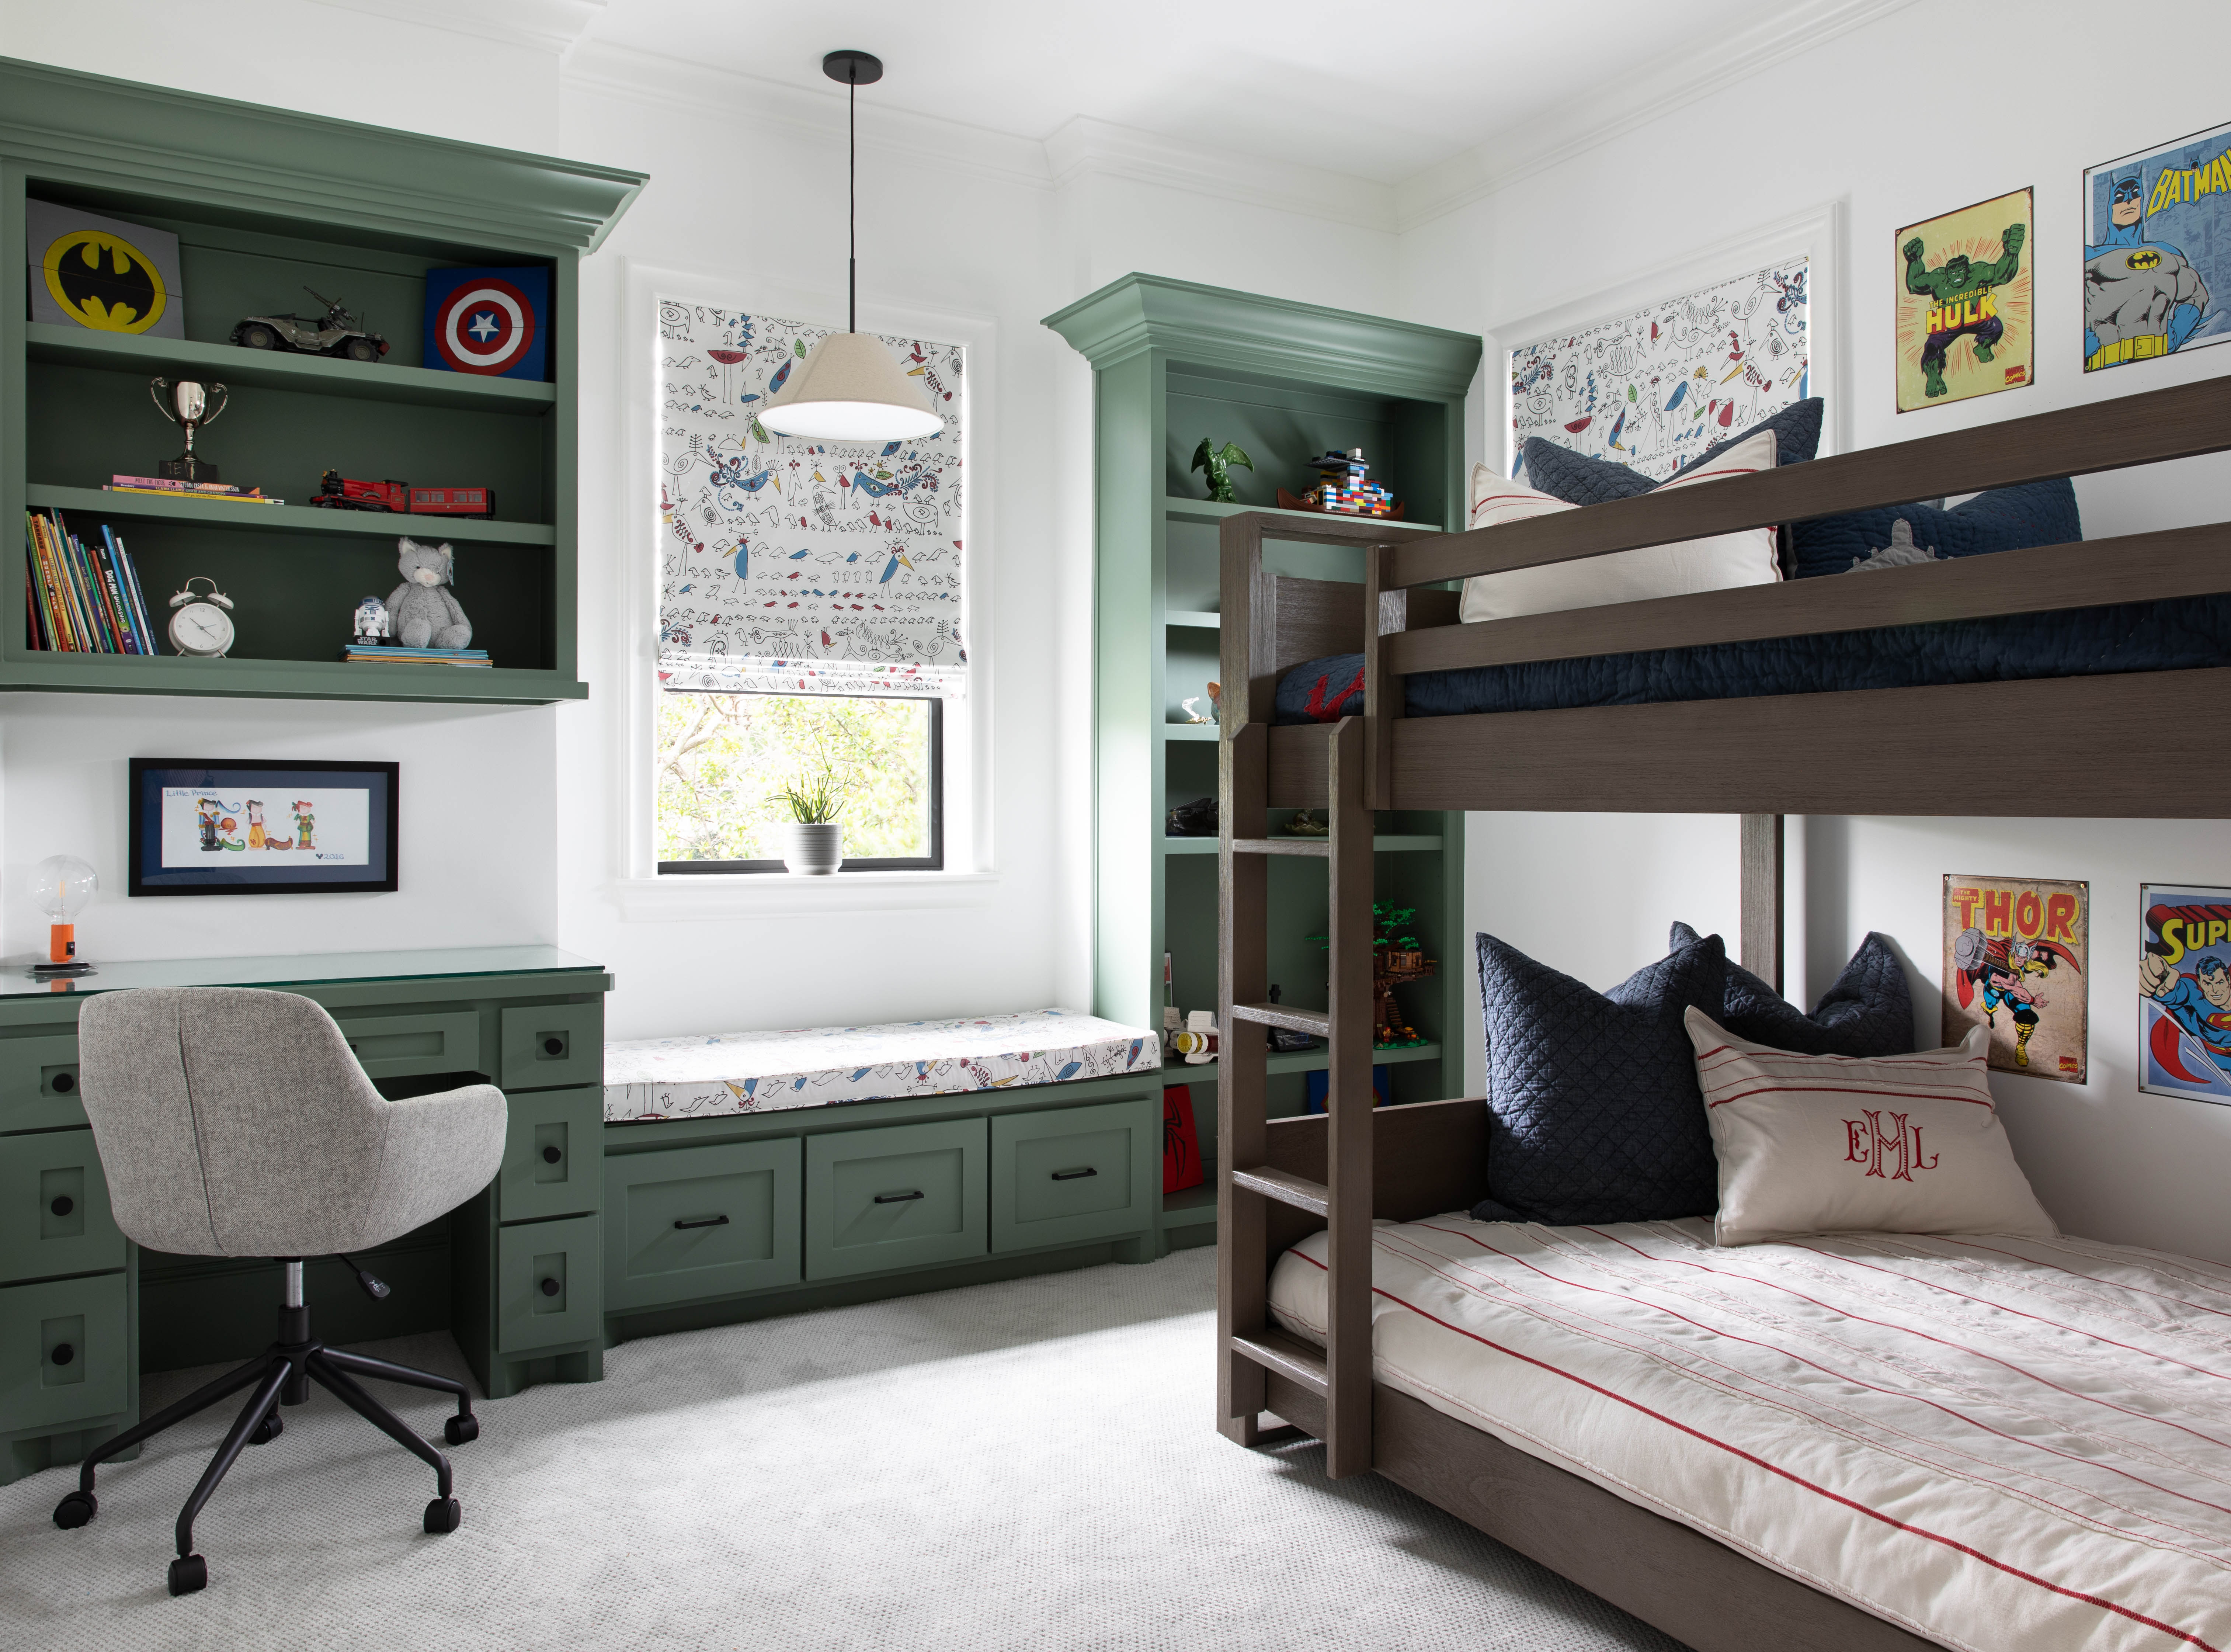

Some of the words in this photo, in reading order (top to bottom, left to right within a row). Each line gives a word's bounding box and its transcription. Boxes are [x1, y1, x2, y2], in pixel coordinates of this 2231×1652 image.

[1929, 299, 1943, 308] THE
[1946, 285, 1992, 304] INCREDIBLE
[1925, 293, 1998, 334] HULK
[2005, 371, 2025, 383] COMICS
[34, 520, 44, 549] TANKARD
[104, 569, 115, 583] DOG
[108, 581, 119, 596] MAN
[1952, 887, 2080, 944] THOR
[2161, 917, 2231, 965] SUP
